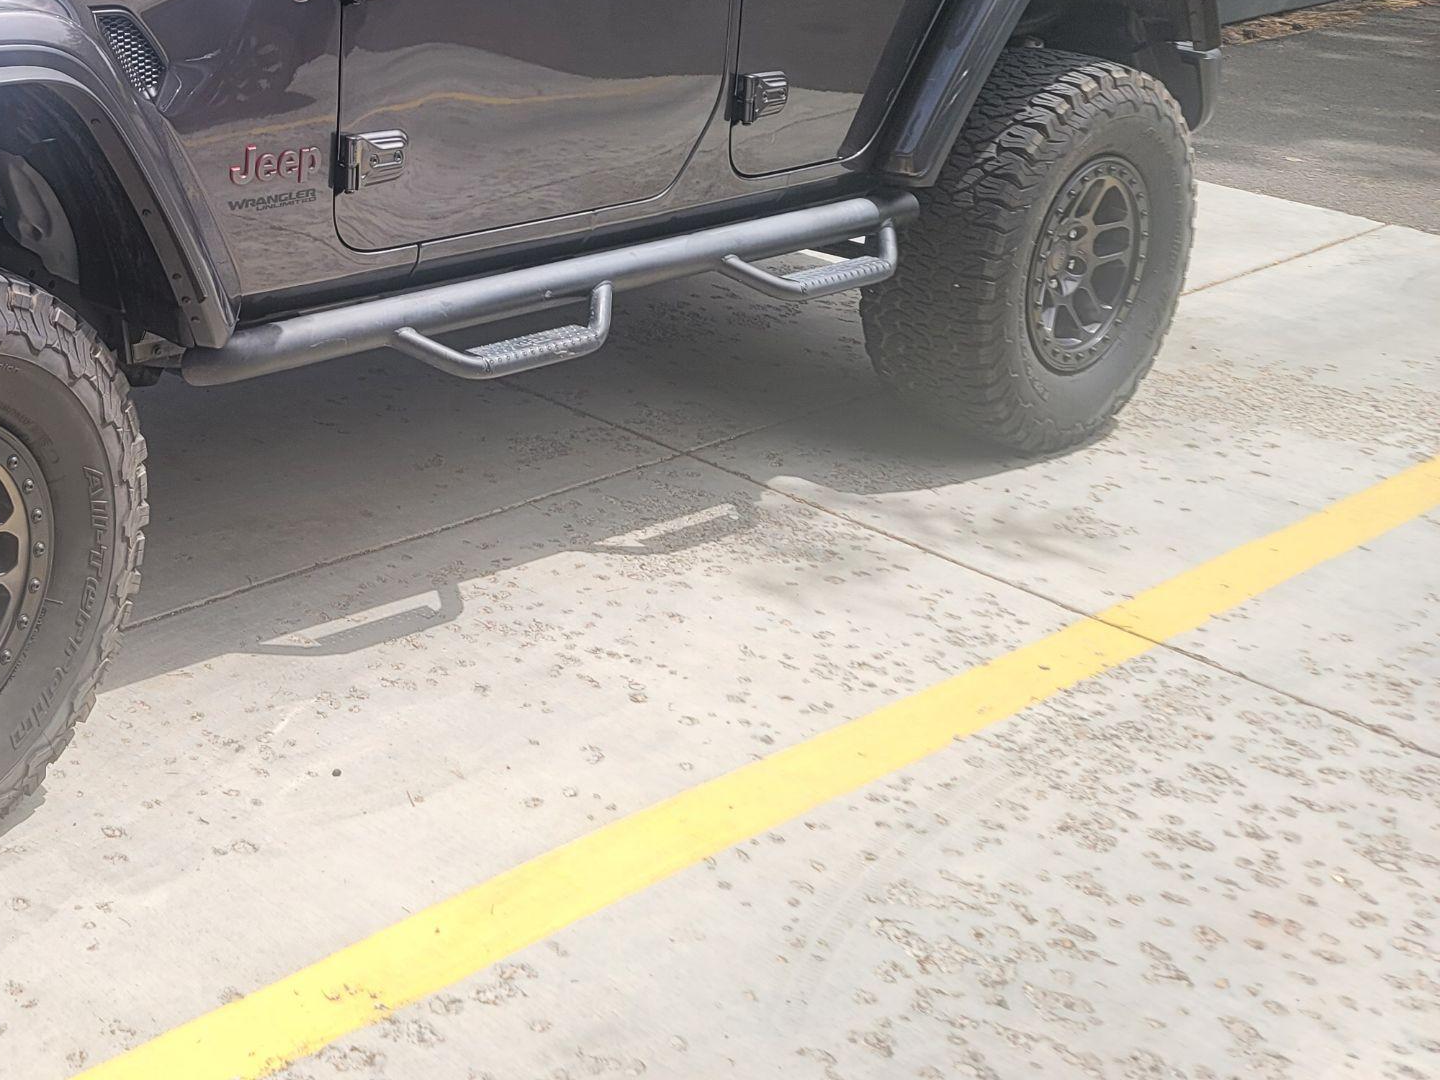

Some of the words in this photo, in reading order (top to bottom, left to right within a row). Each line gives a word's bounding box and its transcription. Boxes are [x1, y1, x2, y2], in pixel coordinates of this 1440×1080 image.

[229, 143, 322, 186] Jeep
[227, 188, 316, 211] WRANGLER
[256, 196, 317, 211] UNLIMITED
